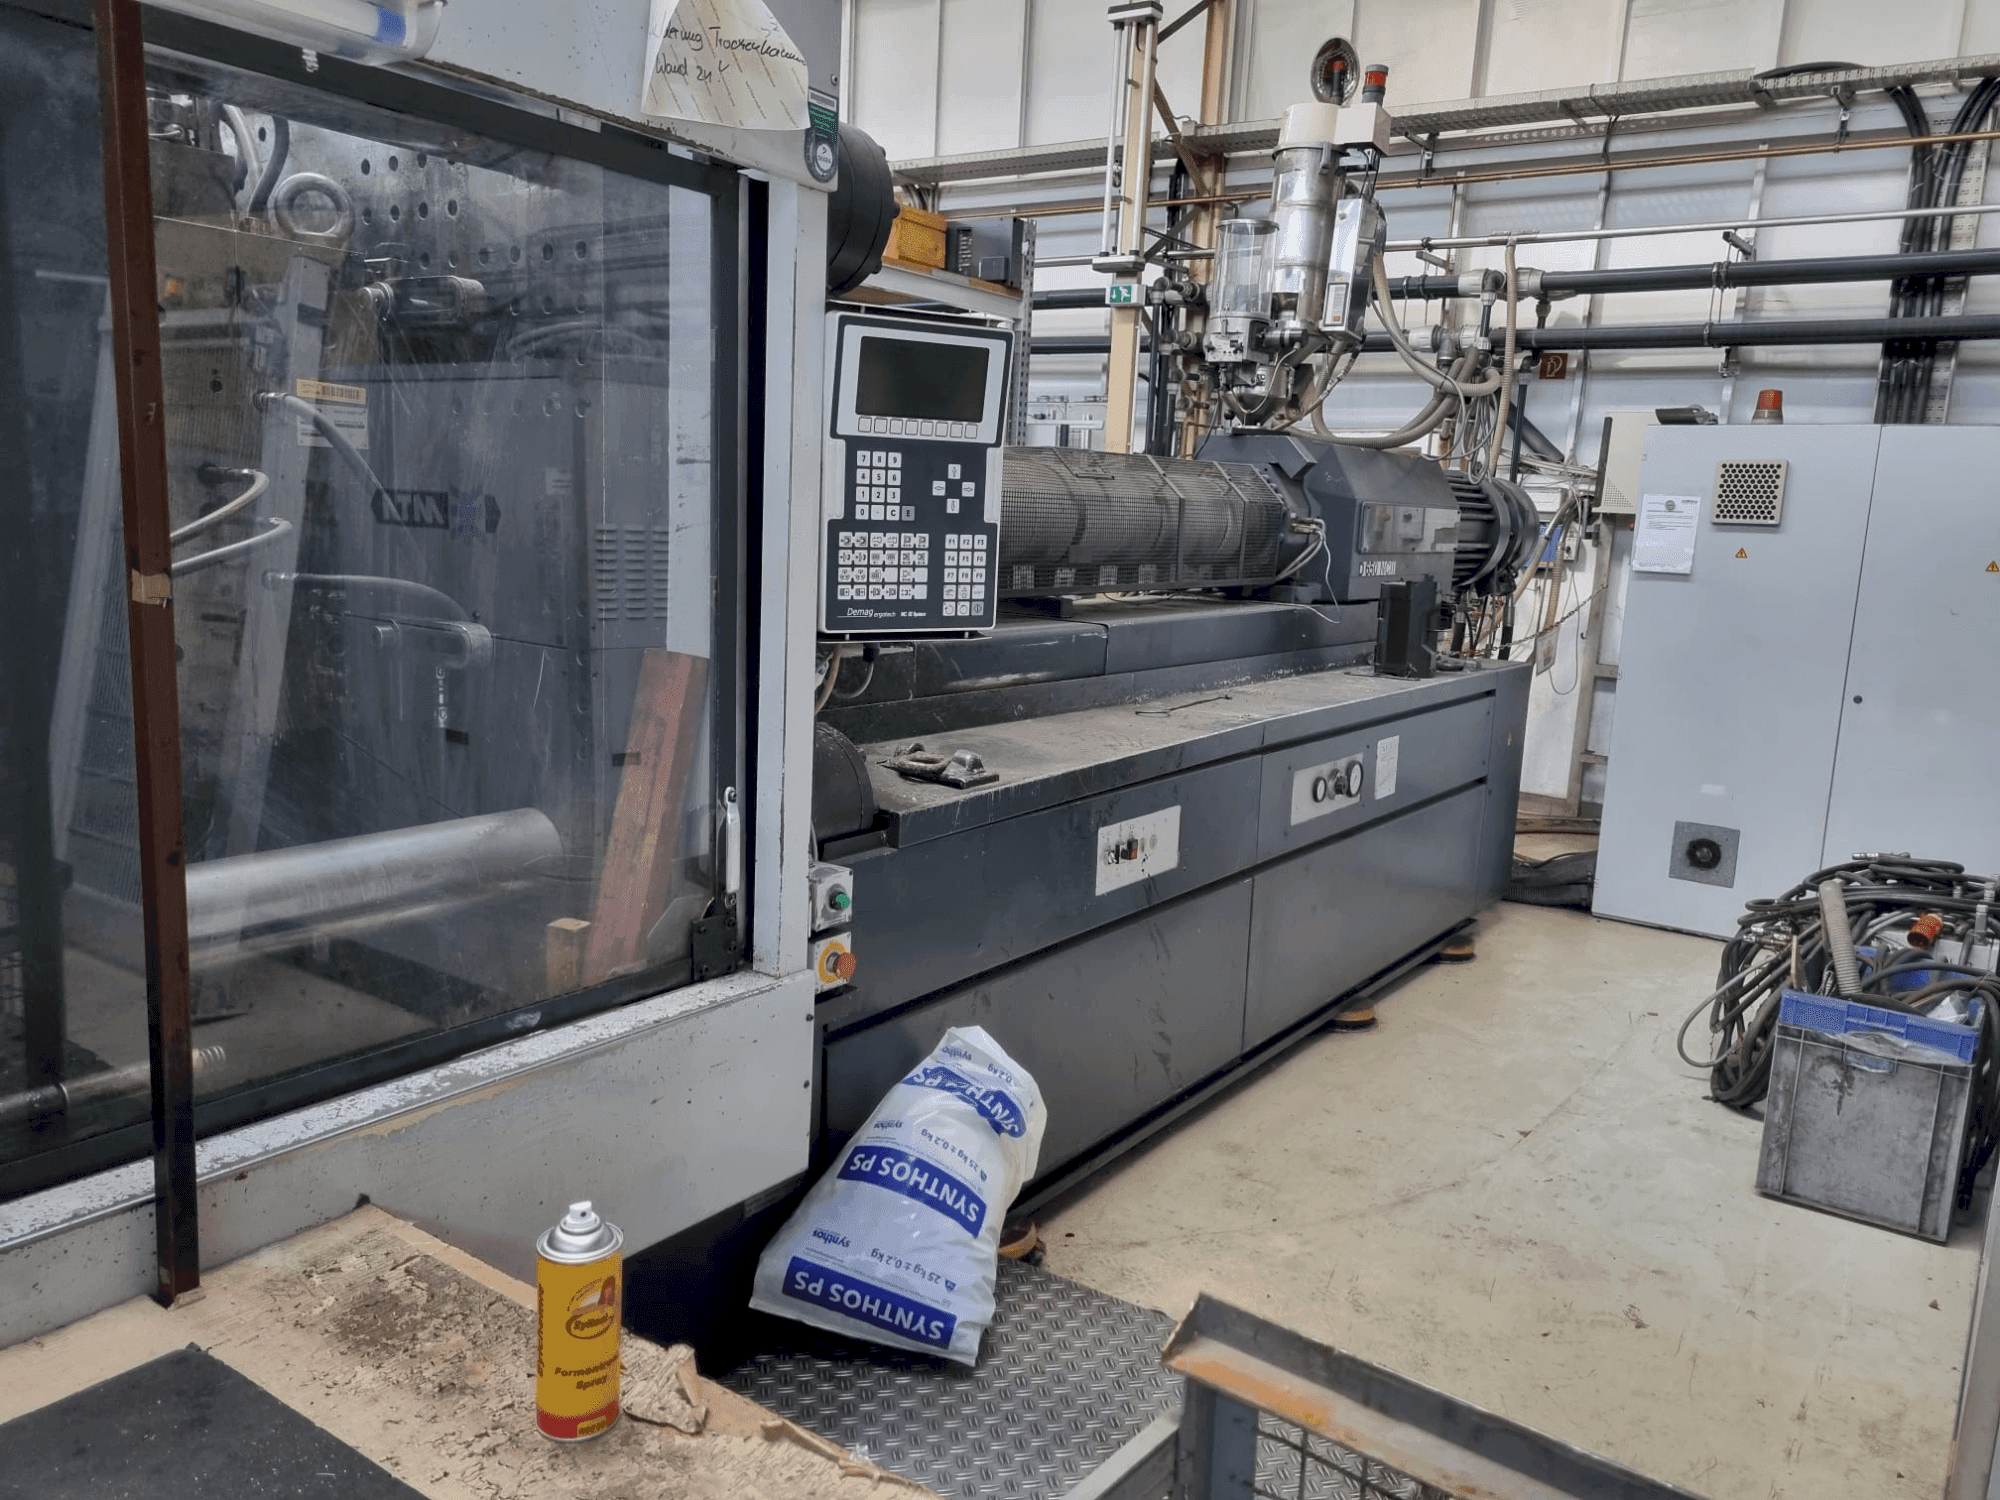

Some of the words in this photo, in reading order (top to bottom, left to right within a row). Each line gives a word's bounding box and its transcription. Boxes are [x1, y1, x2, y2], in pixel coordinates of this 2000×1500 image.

[890, 509, 897, 517] C
[847, 607, 874, 618] Demag
[874, 611, 897, 619] ergotech
[941, 1045, 972, 1061] syntho
[987, 1063, 998, 1074] kg
[921, 1128, 933, 1142] kg
[934, 1136, 950, 1150] 0,2
[850, 1154, 877, 1172] PS
[957, 1149, 969, 1164] kg
[969, 1159, 979, 1171] 25
[878, 1157, 979, 1222] SYNTHOS
[812, 1229, 850, 1248] synthos
[871, 1248, 885, 1262] kg
[886, 1255, 902, 1269] 0,2
[913, 1263, 927, 1279] kg
[794, 1271, 824, 1296] PS
[927, 1272, 941, 1285] 25
[829, 1283, 944, 1339] SYNTHOS
